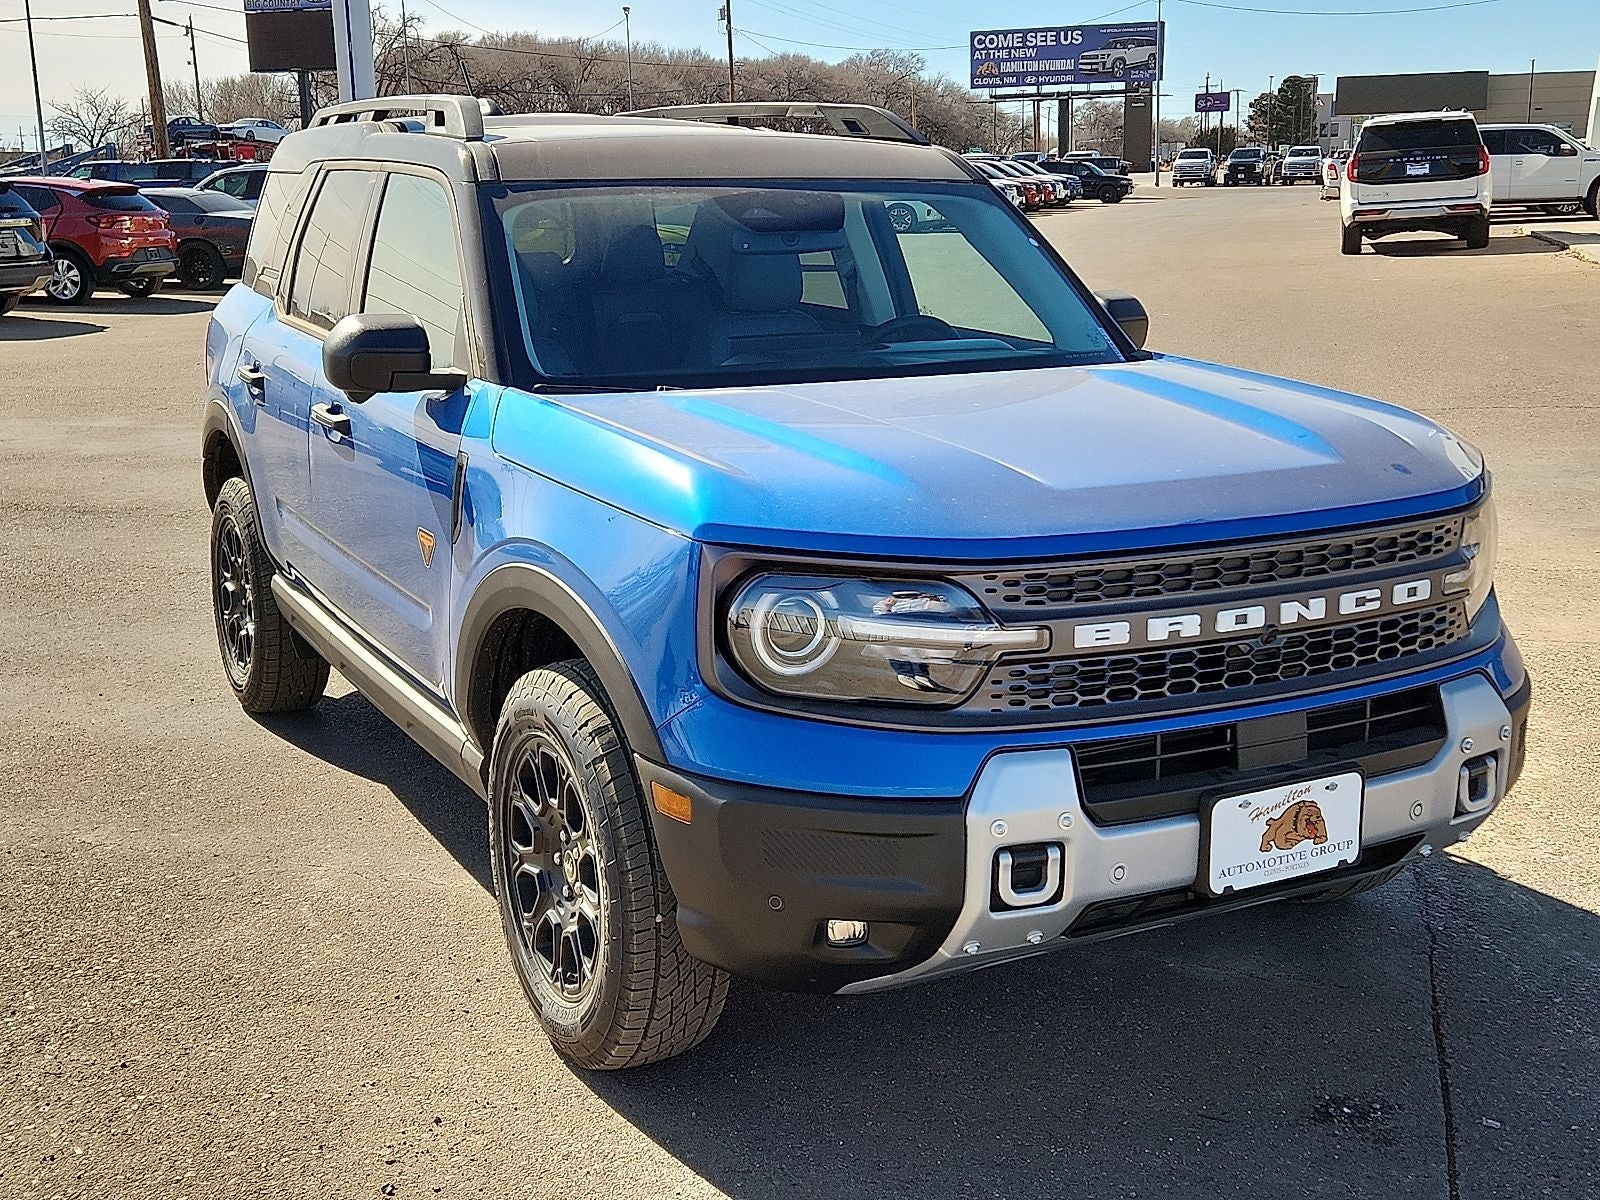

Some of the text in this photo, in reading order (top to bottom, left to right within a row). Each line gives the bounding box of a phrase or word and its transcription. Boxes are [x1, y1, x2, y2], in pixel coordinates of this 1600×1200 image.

[246, 0, 301, 9] BIG COUNTRY
[973, 30, 1083, 49] COME SEE US
[973, 47, 1037, 60] AT THE NEW
[1000, 58, 1075, 73] HAMILTON HYUNDAI
[1003, 76, 1017, 84] NM
[1038, 74, 1074, 83] HYUNDAI
[1073, 578, 1431, 649] BRONCO
[1248, 785, 1313, 823] Hamilton
[1218, 839, 1354, 879] AUTOMOTIVE GROUP
